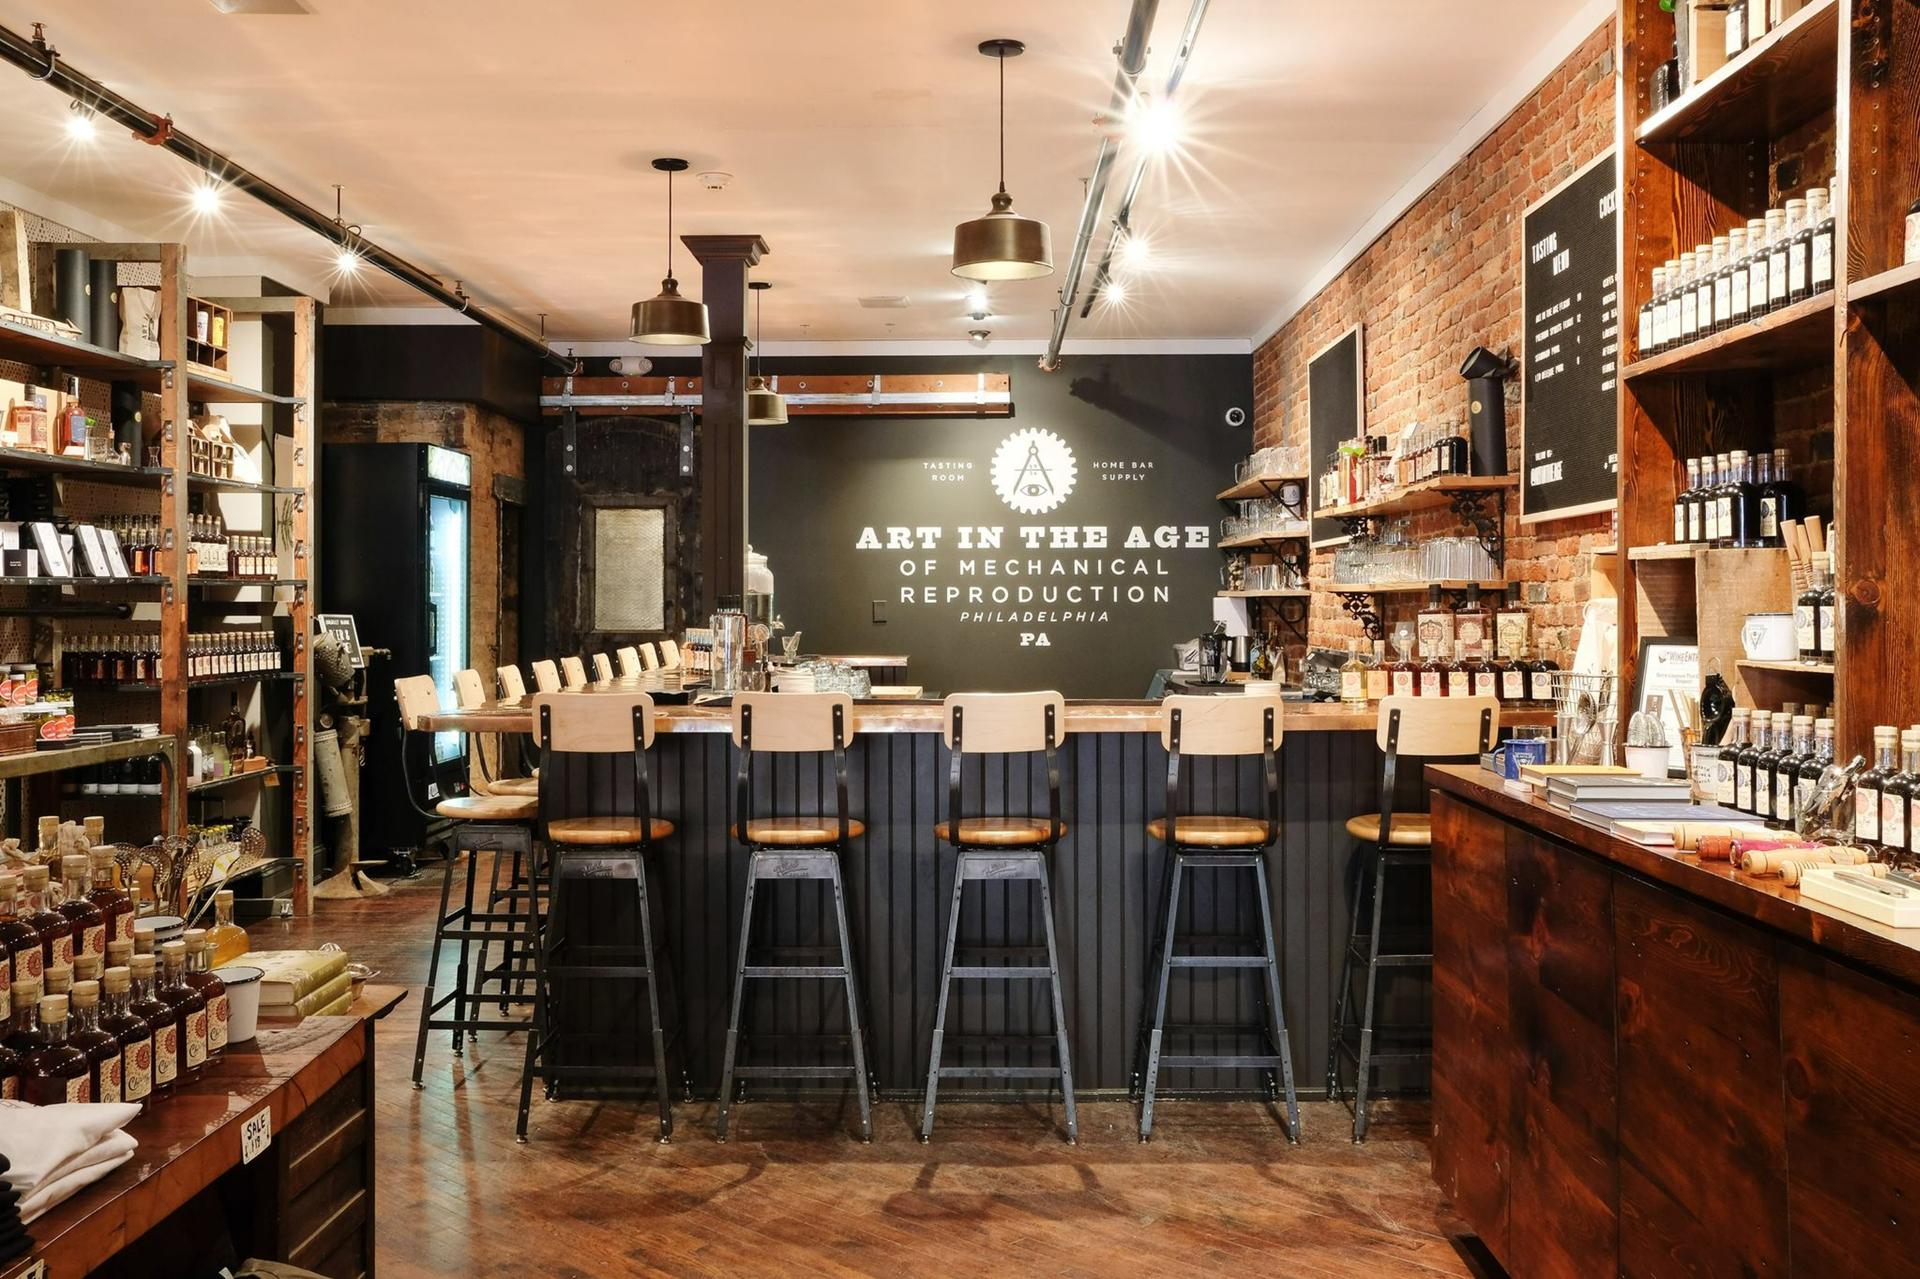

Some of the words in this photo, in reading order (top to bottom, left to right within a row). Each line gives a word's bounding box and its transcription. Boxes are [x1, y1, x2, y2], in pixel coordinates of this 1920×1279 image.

[1532, 231, 1558, 264] TASTING
[923, 462, 974, 470] TASTING
[931, 474, 965, 482] ROOM
[855, 526, 942, 550] ART
[957, 526, 1004, 549] IN
[1019, 526, 1108, 549] THE
[1123, 526, 1210, 549] AGE
[900, 559, 937, 576] OF
[960, 559, 1169, 576] MECHANICAL
[901, 586, 1169, 604] REPRODUCTION
[960, 611, 1109, 623] PHILADELPHIA
[1020, 632, 1051, 647] PA
[247, 1114, 265, 1140] SALE
